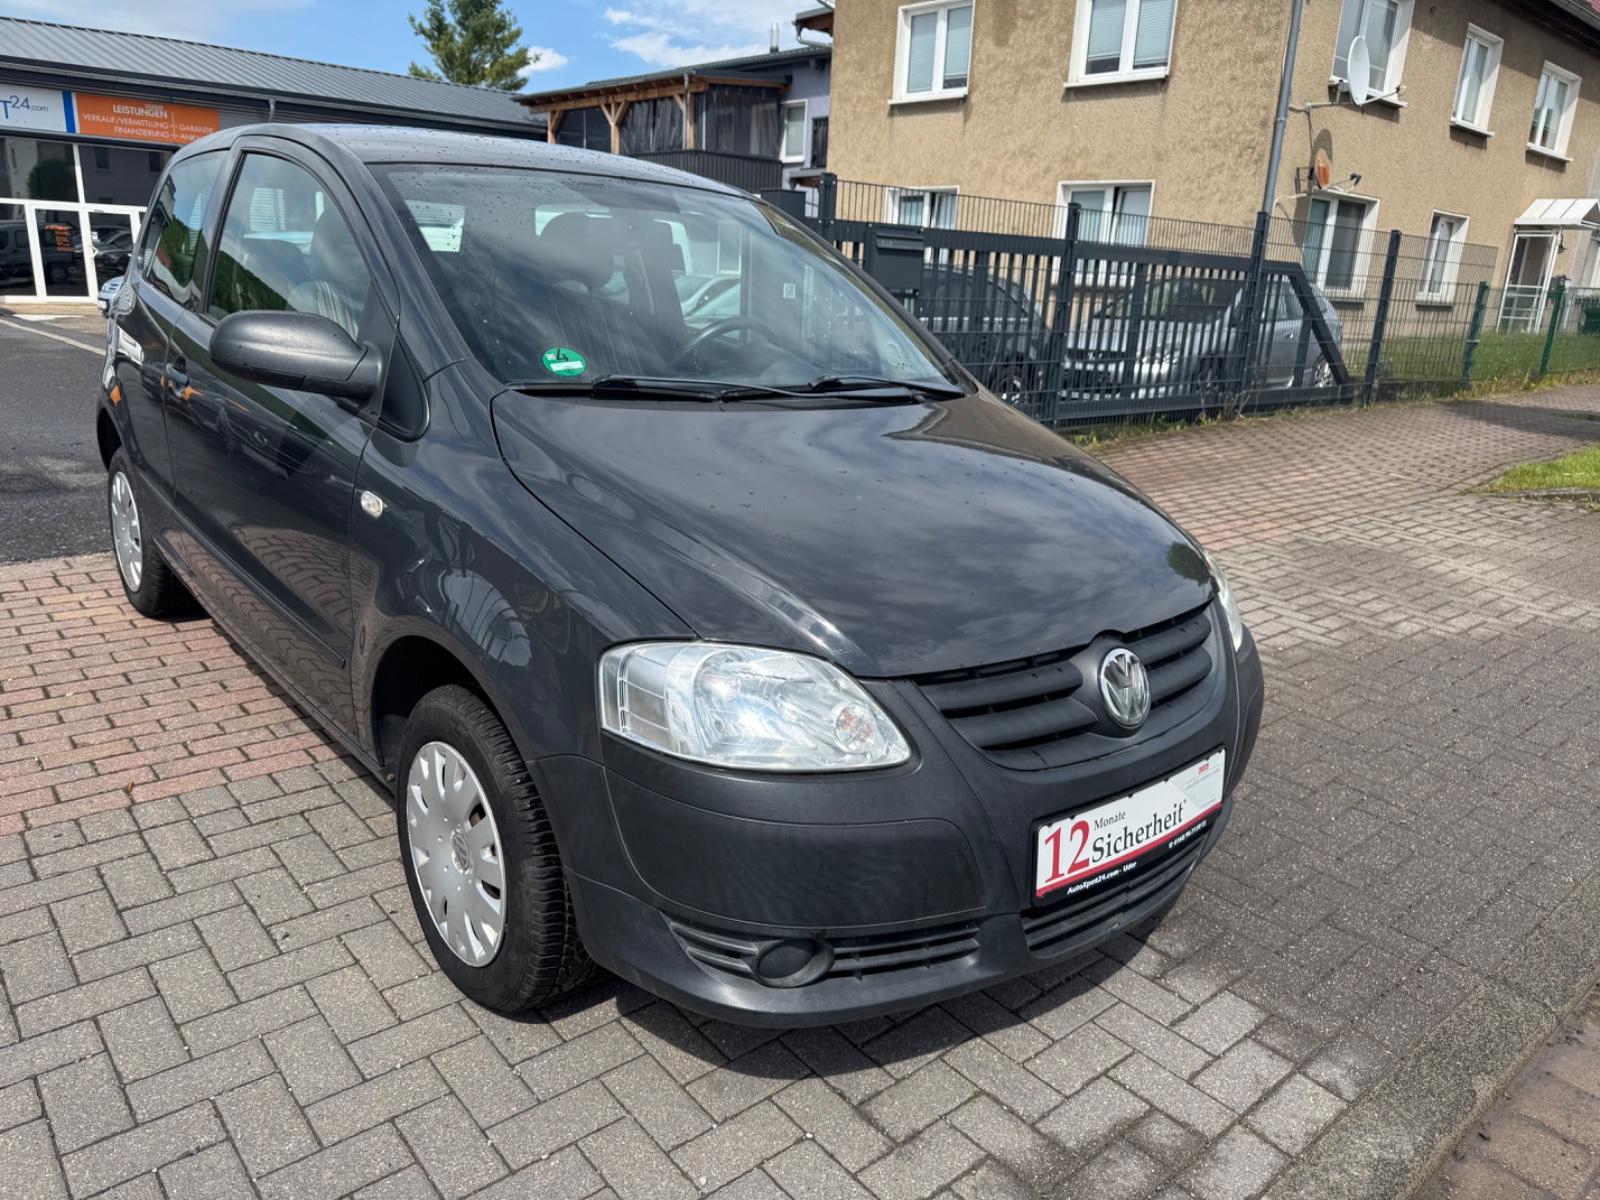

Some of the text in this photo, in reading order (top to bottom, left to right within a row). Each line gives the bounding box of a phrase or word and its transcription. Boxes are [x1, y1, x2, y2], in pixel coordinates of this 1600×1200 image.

[112, 104, 168, 119] LEISTUNGEN
[114, 126, 170, 139] FINANZIERUNG
[1045, 811, 1126, 883] 12 Monate
